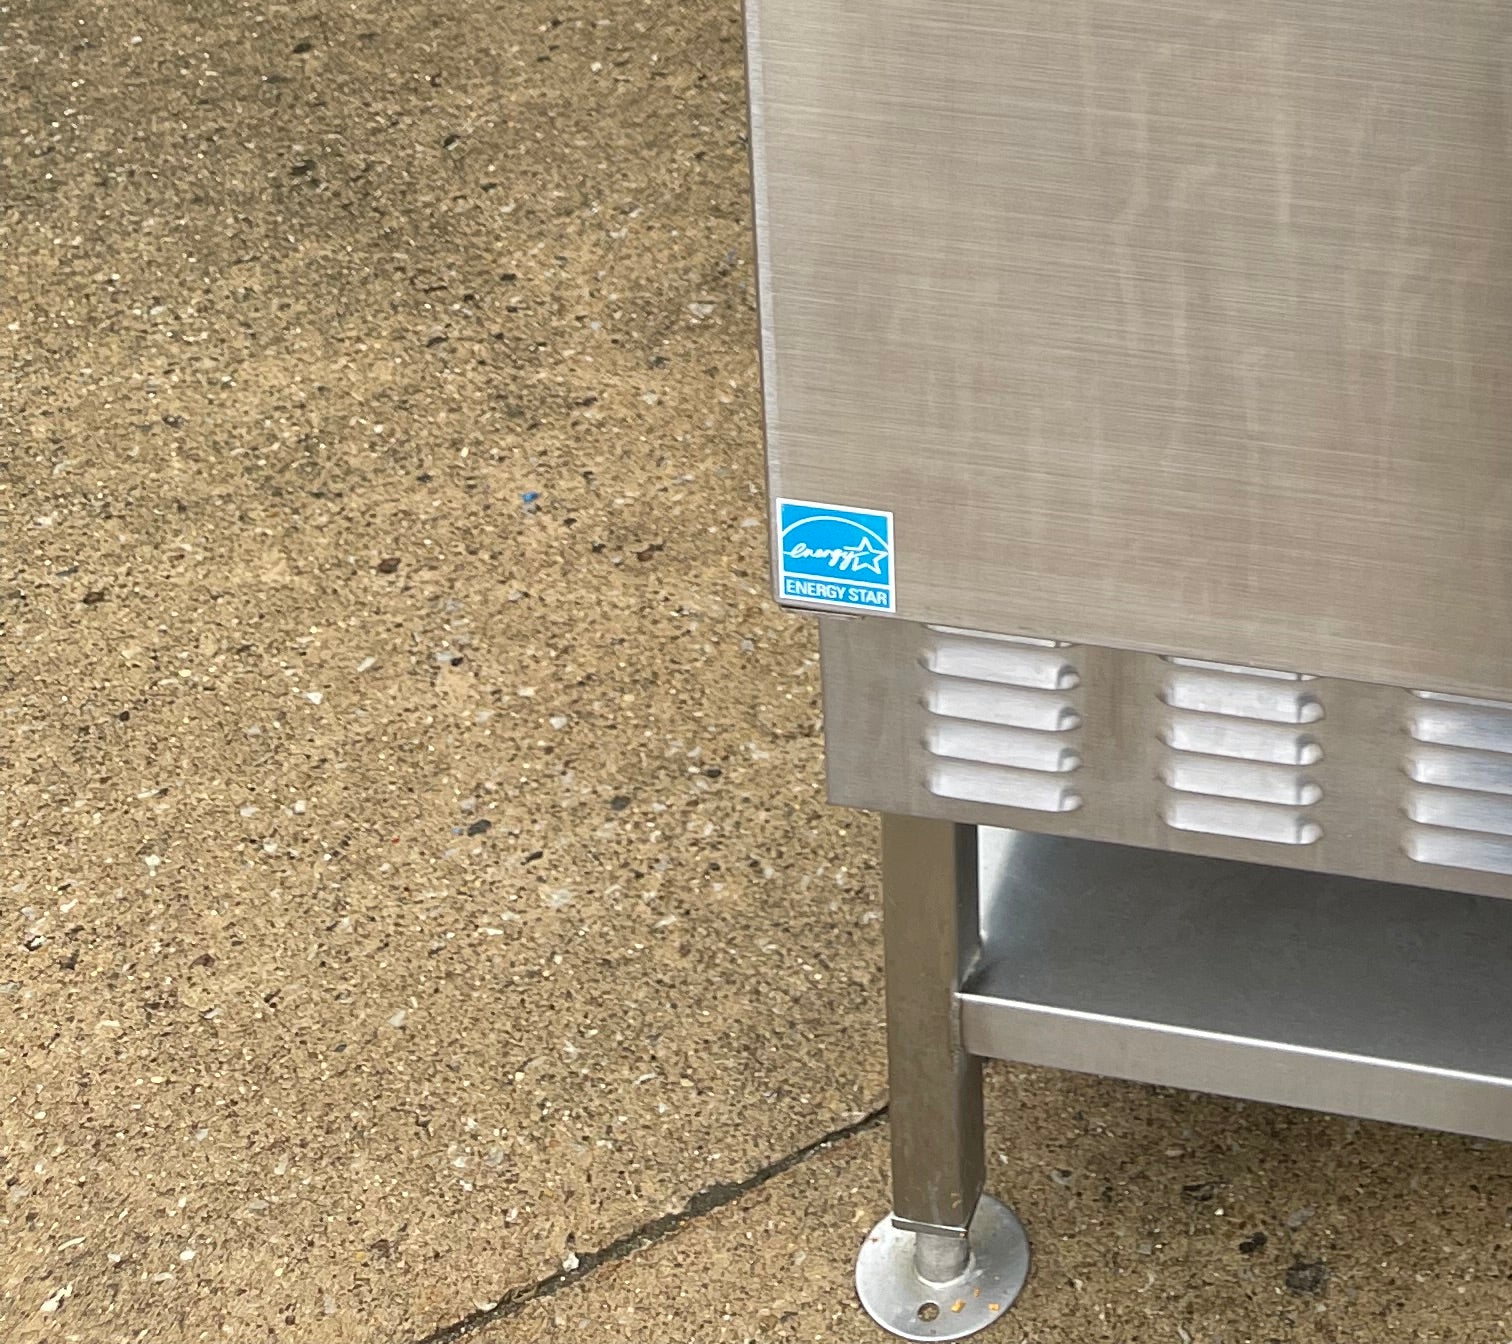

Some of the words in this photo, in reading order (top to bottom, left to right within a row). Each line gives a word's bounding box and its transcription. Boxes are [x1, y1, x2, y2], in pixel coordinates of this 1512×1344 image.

[786, 542, 865, 571] energy
[786, 578, 847, 600] ENERGY
[848, 587, 888, 605] STAR
